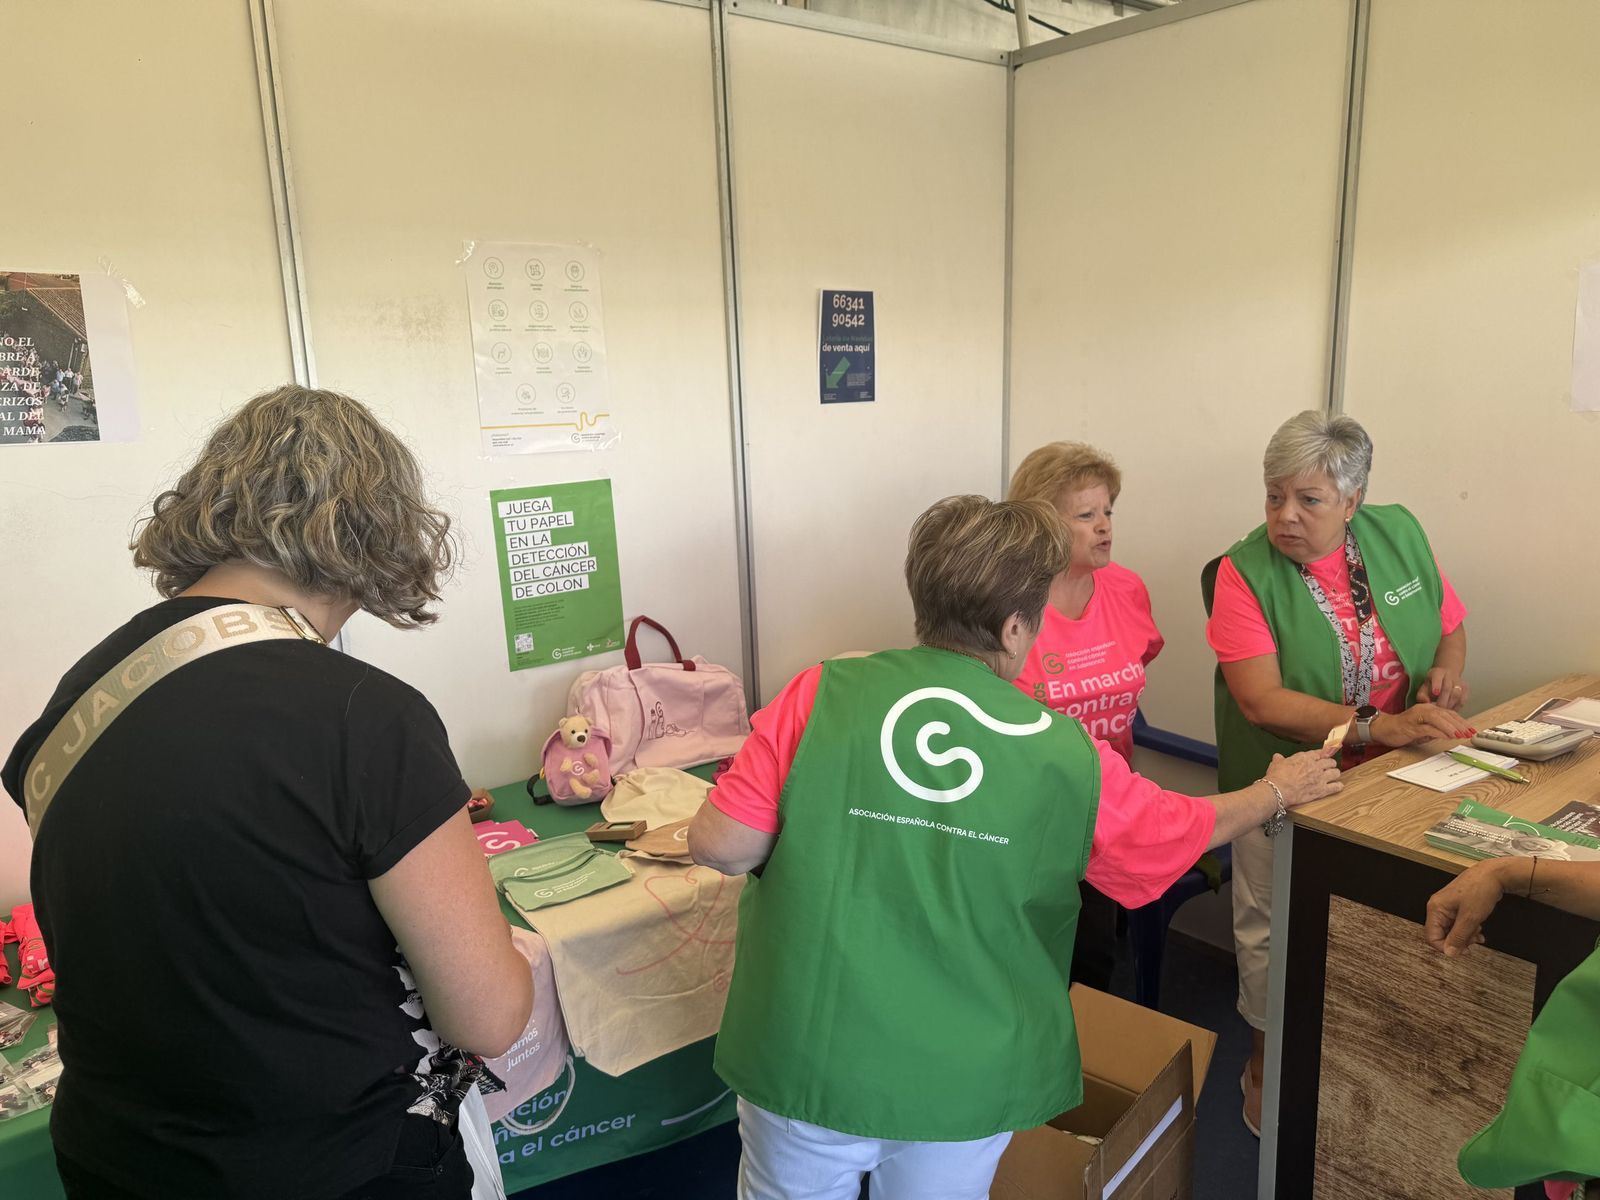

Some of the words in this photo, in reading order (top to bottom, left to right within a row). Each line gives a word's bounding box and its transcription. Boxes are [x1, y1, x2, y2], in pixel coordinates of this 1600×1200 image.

[833, 294, 865, 311] 66341
[832, 313, 865, 328] 90542
[18, 337, 35, 347] EL
[822, 343, 832, 352] de
[833, 343, 853, 352] venta
[0, 397, 43, 407] RIZOS
[506, 499, 551, 515] JUEGA
[507, 518, 527, 532] TU
[531, 514, 572, 529] PAPEL
[510, 535, 529, 549] EN
[532, 533, 550, 546] LA
[511, 543, 588, 566] DETECCIÓN
[513, 568, 540, 582] DEL
[542, 559, 596, 578] CÁNCER
[515, 585, 534, 599] DE
[536, 577, 583, 596] COLON
[62, 609, 305, 755] JACOBS
[1048, 680, 1078, 700] En
[848, 808, 895, 823] ASOCIACIÓN
[896, 816, 935, 829] ESPAÑOLA
[936, 822, 967, 837] CONTRA
[968, 830, 977, 839] EL
[978, 832, 1009, 845] CÁNCER
[506, 1041, 541, 1072] juntos
[521, 1135, 543, 1157] el
[550, 1113, 636, 1147] cáncer
